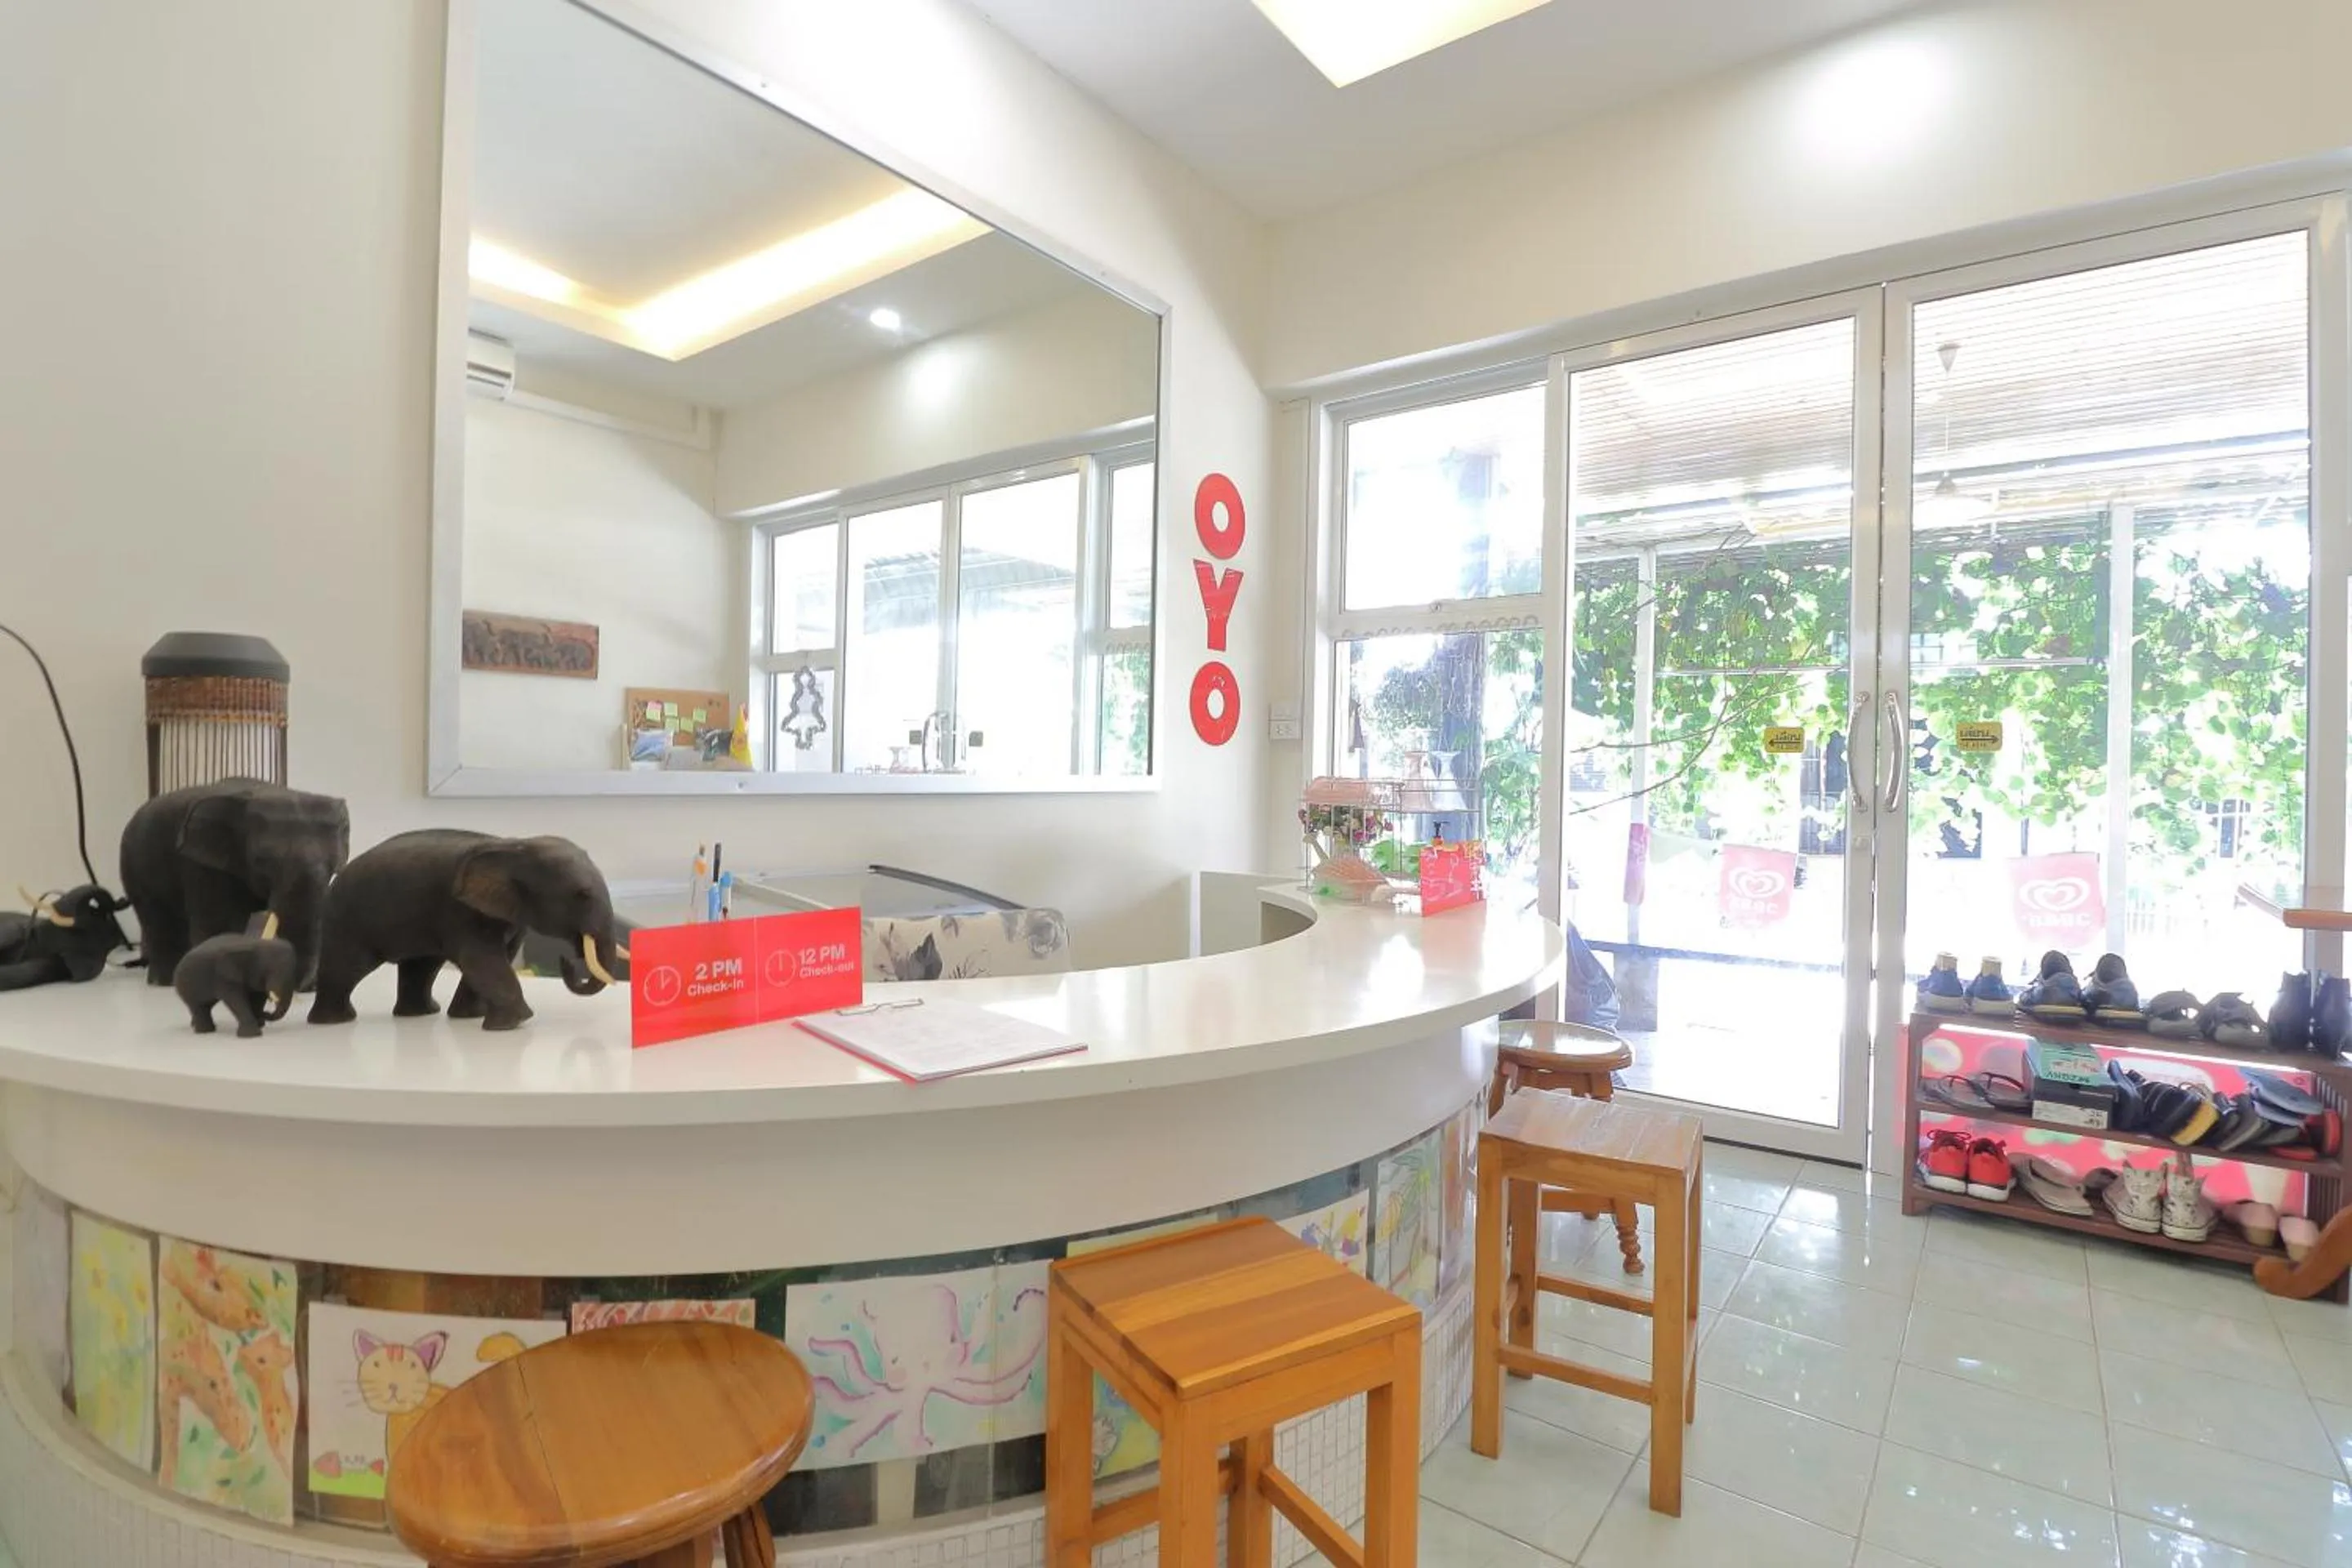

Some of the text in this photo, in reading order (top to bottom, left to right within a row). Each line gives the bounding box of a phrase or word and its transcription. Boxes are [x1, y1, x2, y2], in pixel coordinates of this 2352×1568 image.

[1190, 473, 1245, 746] OYO
[797, 942, 846, 964] 12 PM
[695, 957, 742, 981] 2 PM
[800, 960, 855, 978] Check-out
[687, 978, 744, 996] Check-in
